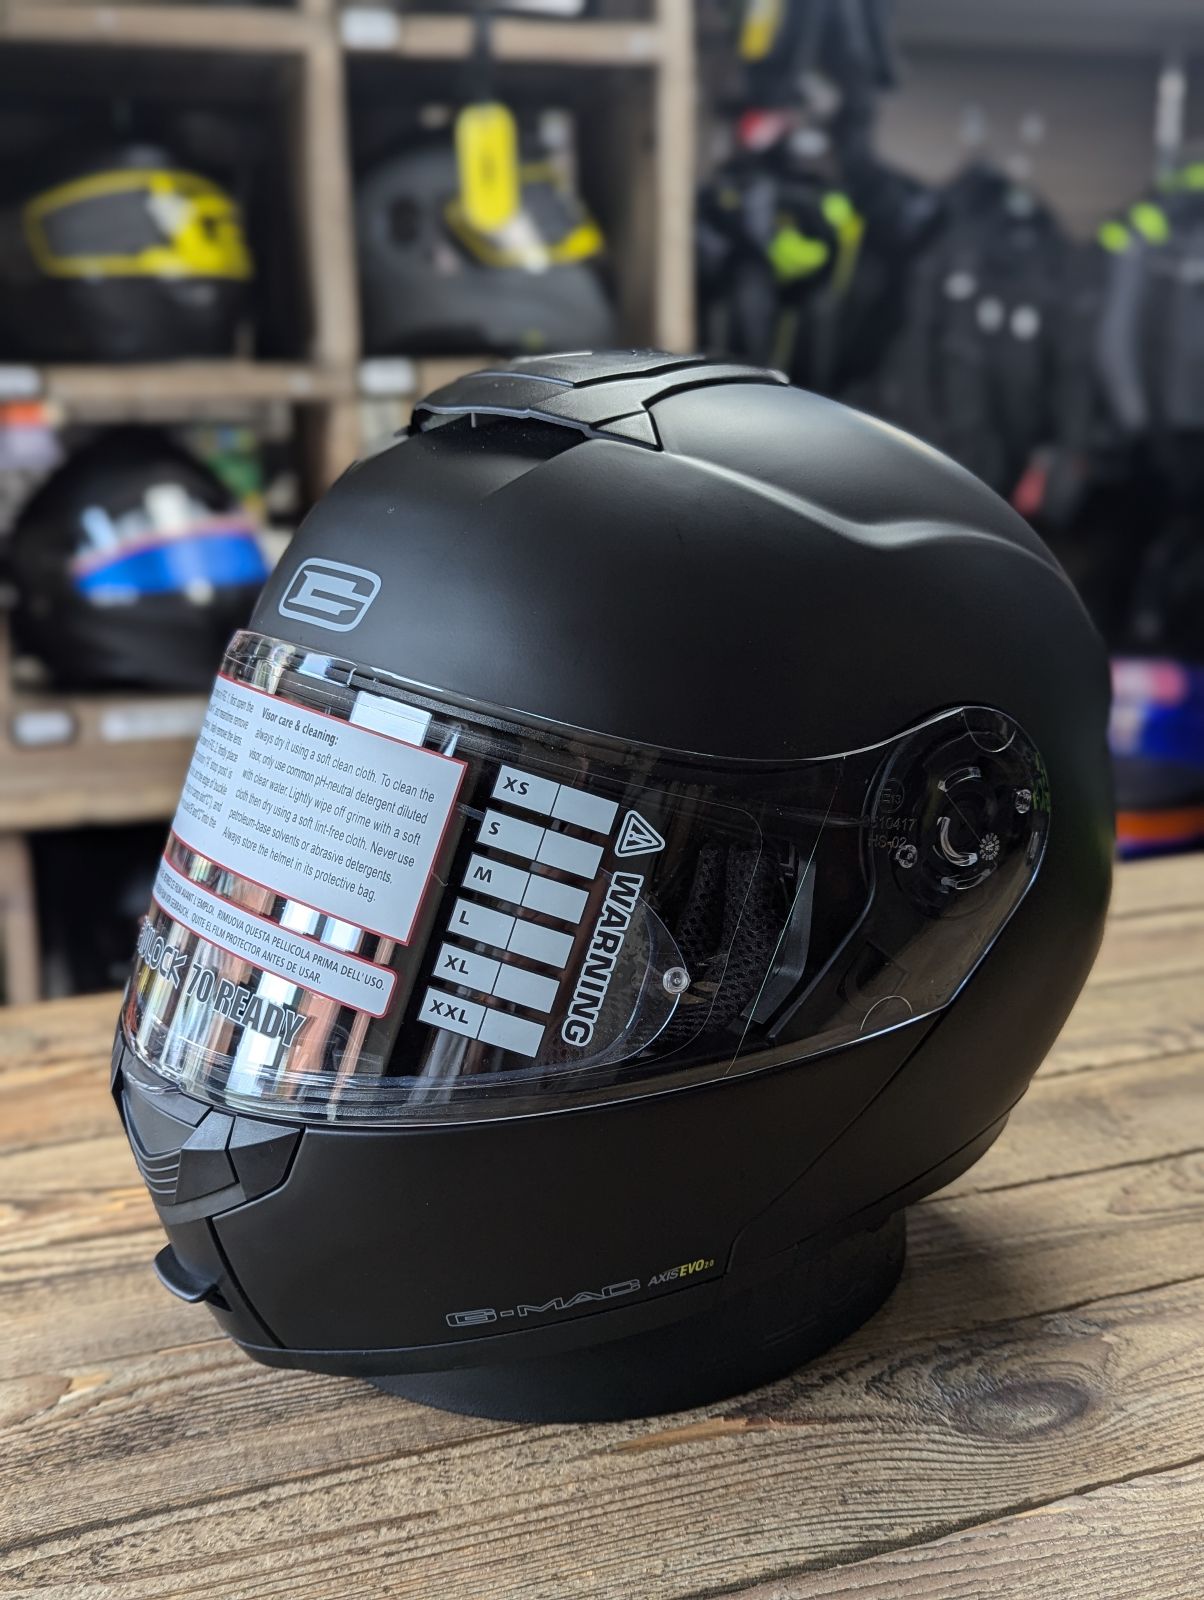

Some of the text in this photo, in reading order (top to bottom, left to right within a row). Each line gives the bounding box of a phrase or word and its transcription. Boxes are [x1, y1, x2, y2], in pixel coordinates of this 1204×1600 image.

[262, 706, 339, 747] Visor care & cleaning:
[254, 728, 435, 803] always dry it using a soft clean cloth. To clean the
[262, 755, 275, 770] only
[275, 761, 286, 772] use
[286, 765, 315, 783] common
[313, 775, 355, 798] pH-neutral
[355, 789, 396, 814] detergent
[396, 804, 429, 825] diluted
[502, 776, 530, 797] XS
[235, 787, 415, 868] cloth then dry using a soft lint-free cloth. Never use
[242, 768, 421, 846] with clear water. Lightly wipe off grime with a soft
[487, 820, 502, 836] S
[222, 826, 376, 903] Always store the helmet in its protective bag.
[228, 809, 272, 836] petroleum-base
[271, 829, 300, 848] solvents
[300, 840, 311, 852] or
[310, 843, 344, 865] abrasive
[345, 856, 392, 884] detergents.
[472, 865, 493, 884] M
[191, 912, 207, 931] QUITE
[204, 920, 213, 933] EL
[211, 924, 226, 940] FILM
[225, 931, 261, 955] PROTECTOR
[261, 949, 285, 968] ANTES
[285, 960, 297, 974] DE
[298, 966, 322, 985] USAR.
[217, 909, 245, 932] RIMUOVA
[244, 923, 270, 946] QUESTA
[271, 935, 310, 962] PELLICOLA
[311, 953, 339, 973] PRIMA
[458, 909, 471, 926] L
[444, 954, 469, 975] XL
[561, 871, 644, 1047] WARNING
[186, 962, 216, 1005] 70
[213, 978, 307, 1048] READY
[428, 999, 470, 1024] XXL
